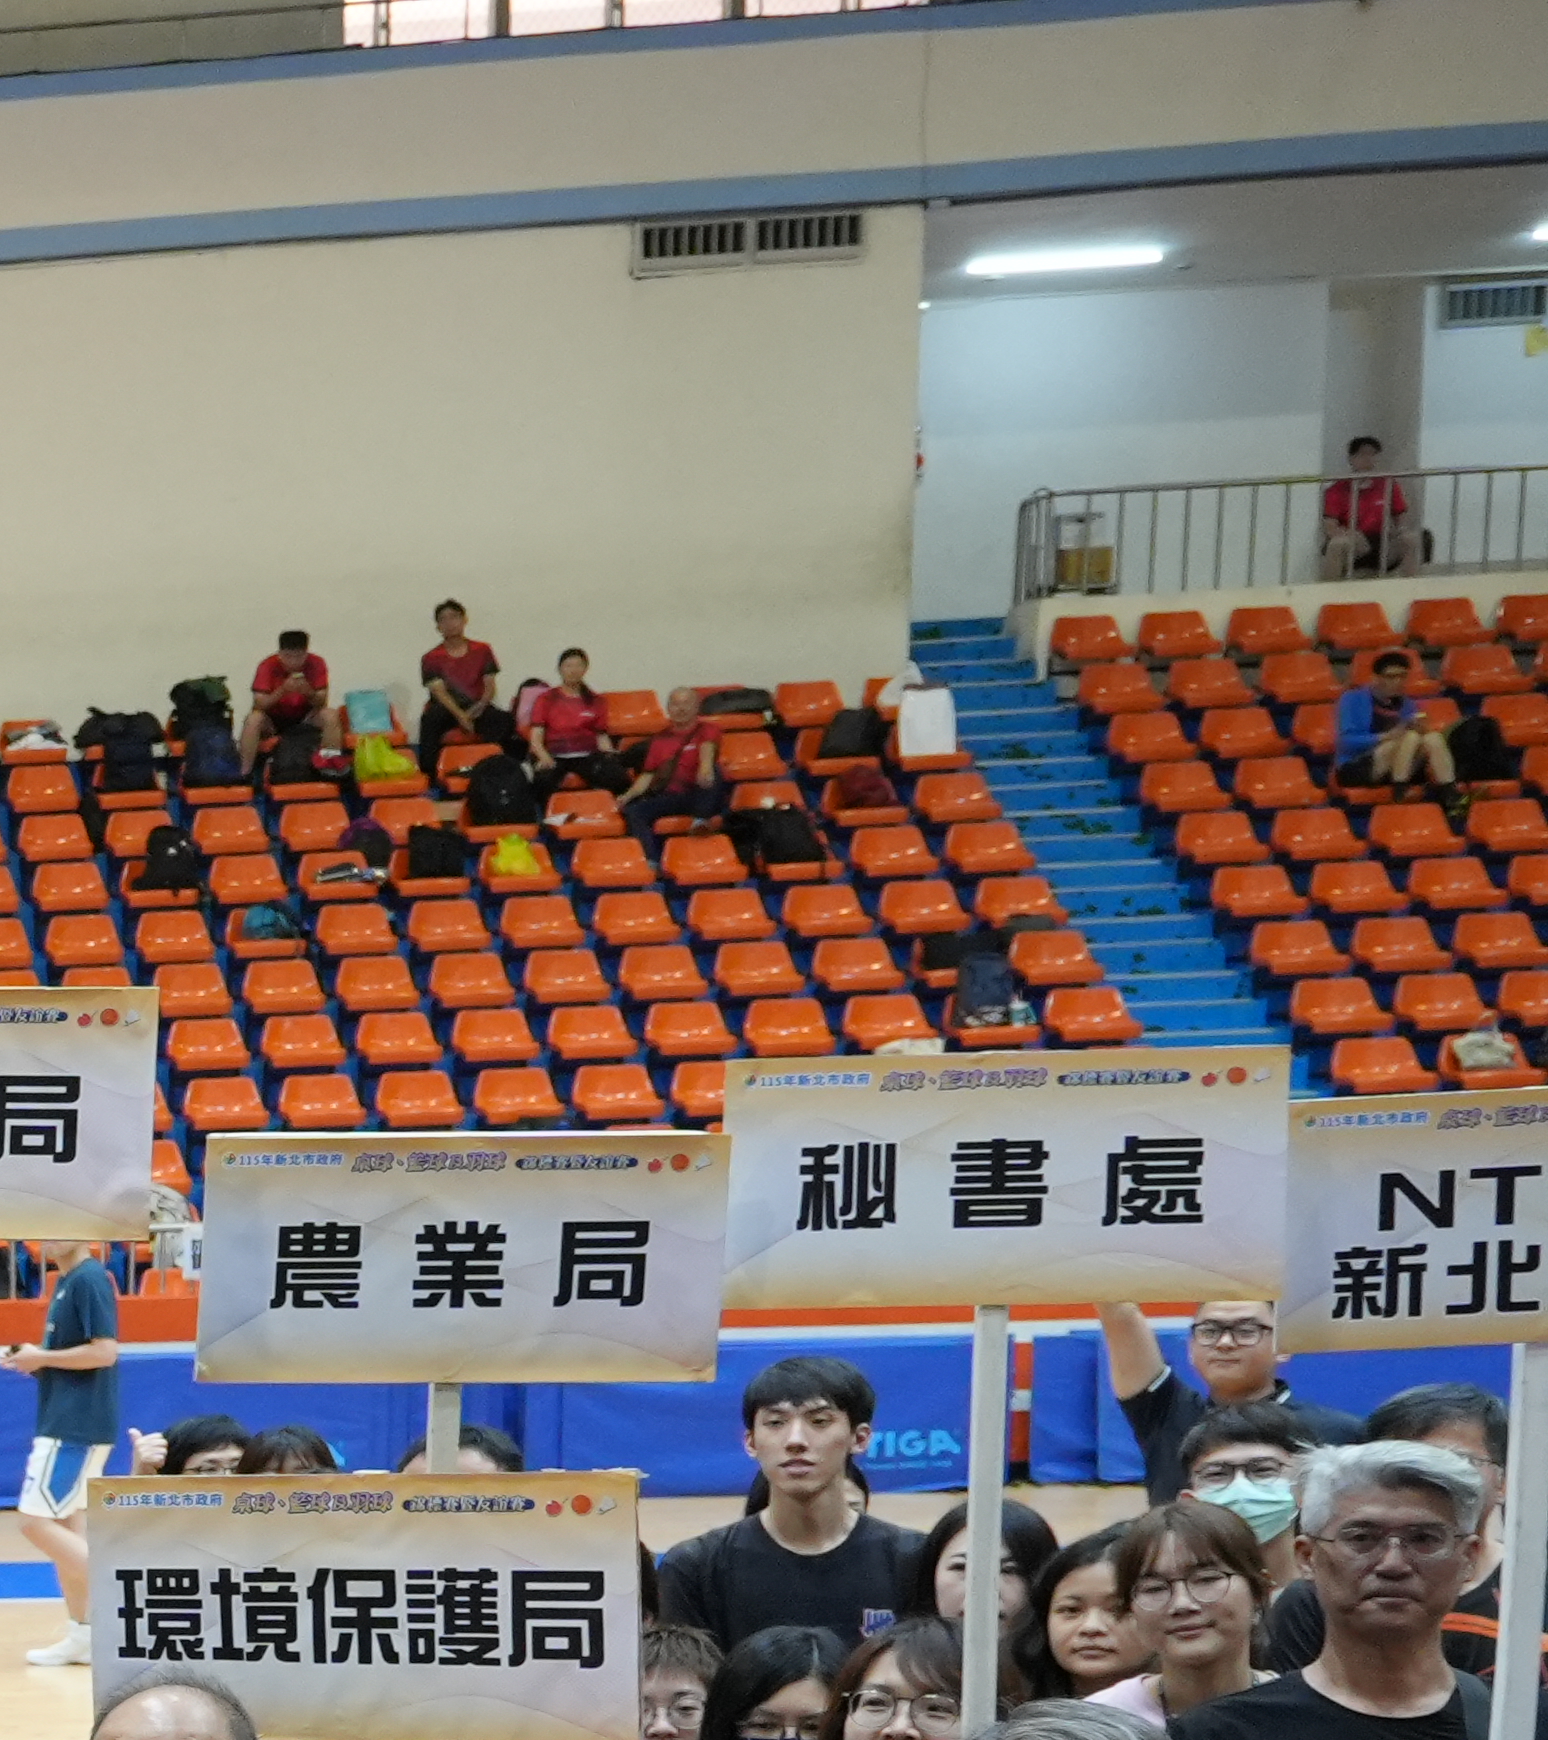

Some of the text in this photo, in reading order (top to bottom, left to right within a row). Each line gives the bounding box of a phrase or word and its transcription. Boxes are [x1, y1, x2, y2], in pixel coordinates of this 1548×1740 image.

[239, 1152, 342, 1167] 115年新北市政府
[796, 1136, 1205, 1232] 秘書處
[1377, 1165, 1543, 1231] NT
[269, 1220, 650, 1309] 農業局
[1332, 1240, 1541, 1319] 新北
[119, 1493, 223, 1508] 115年新北市政府
[114, 1567, 606, 1670] 環境保護局
